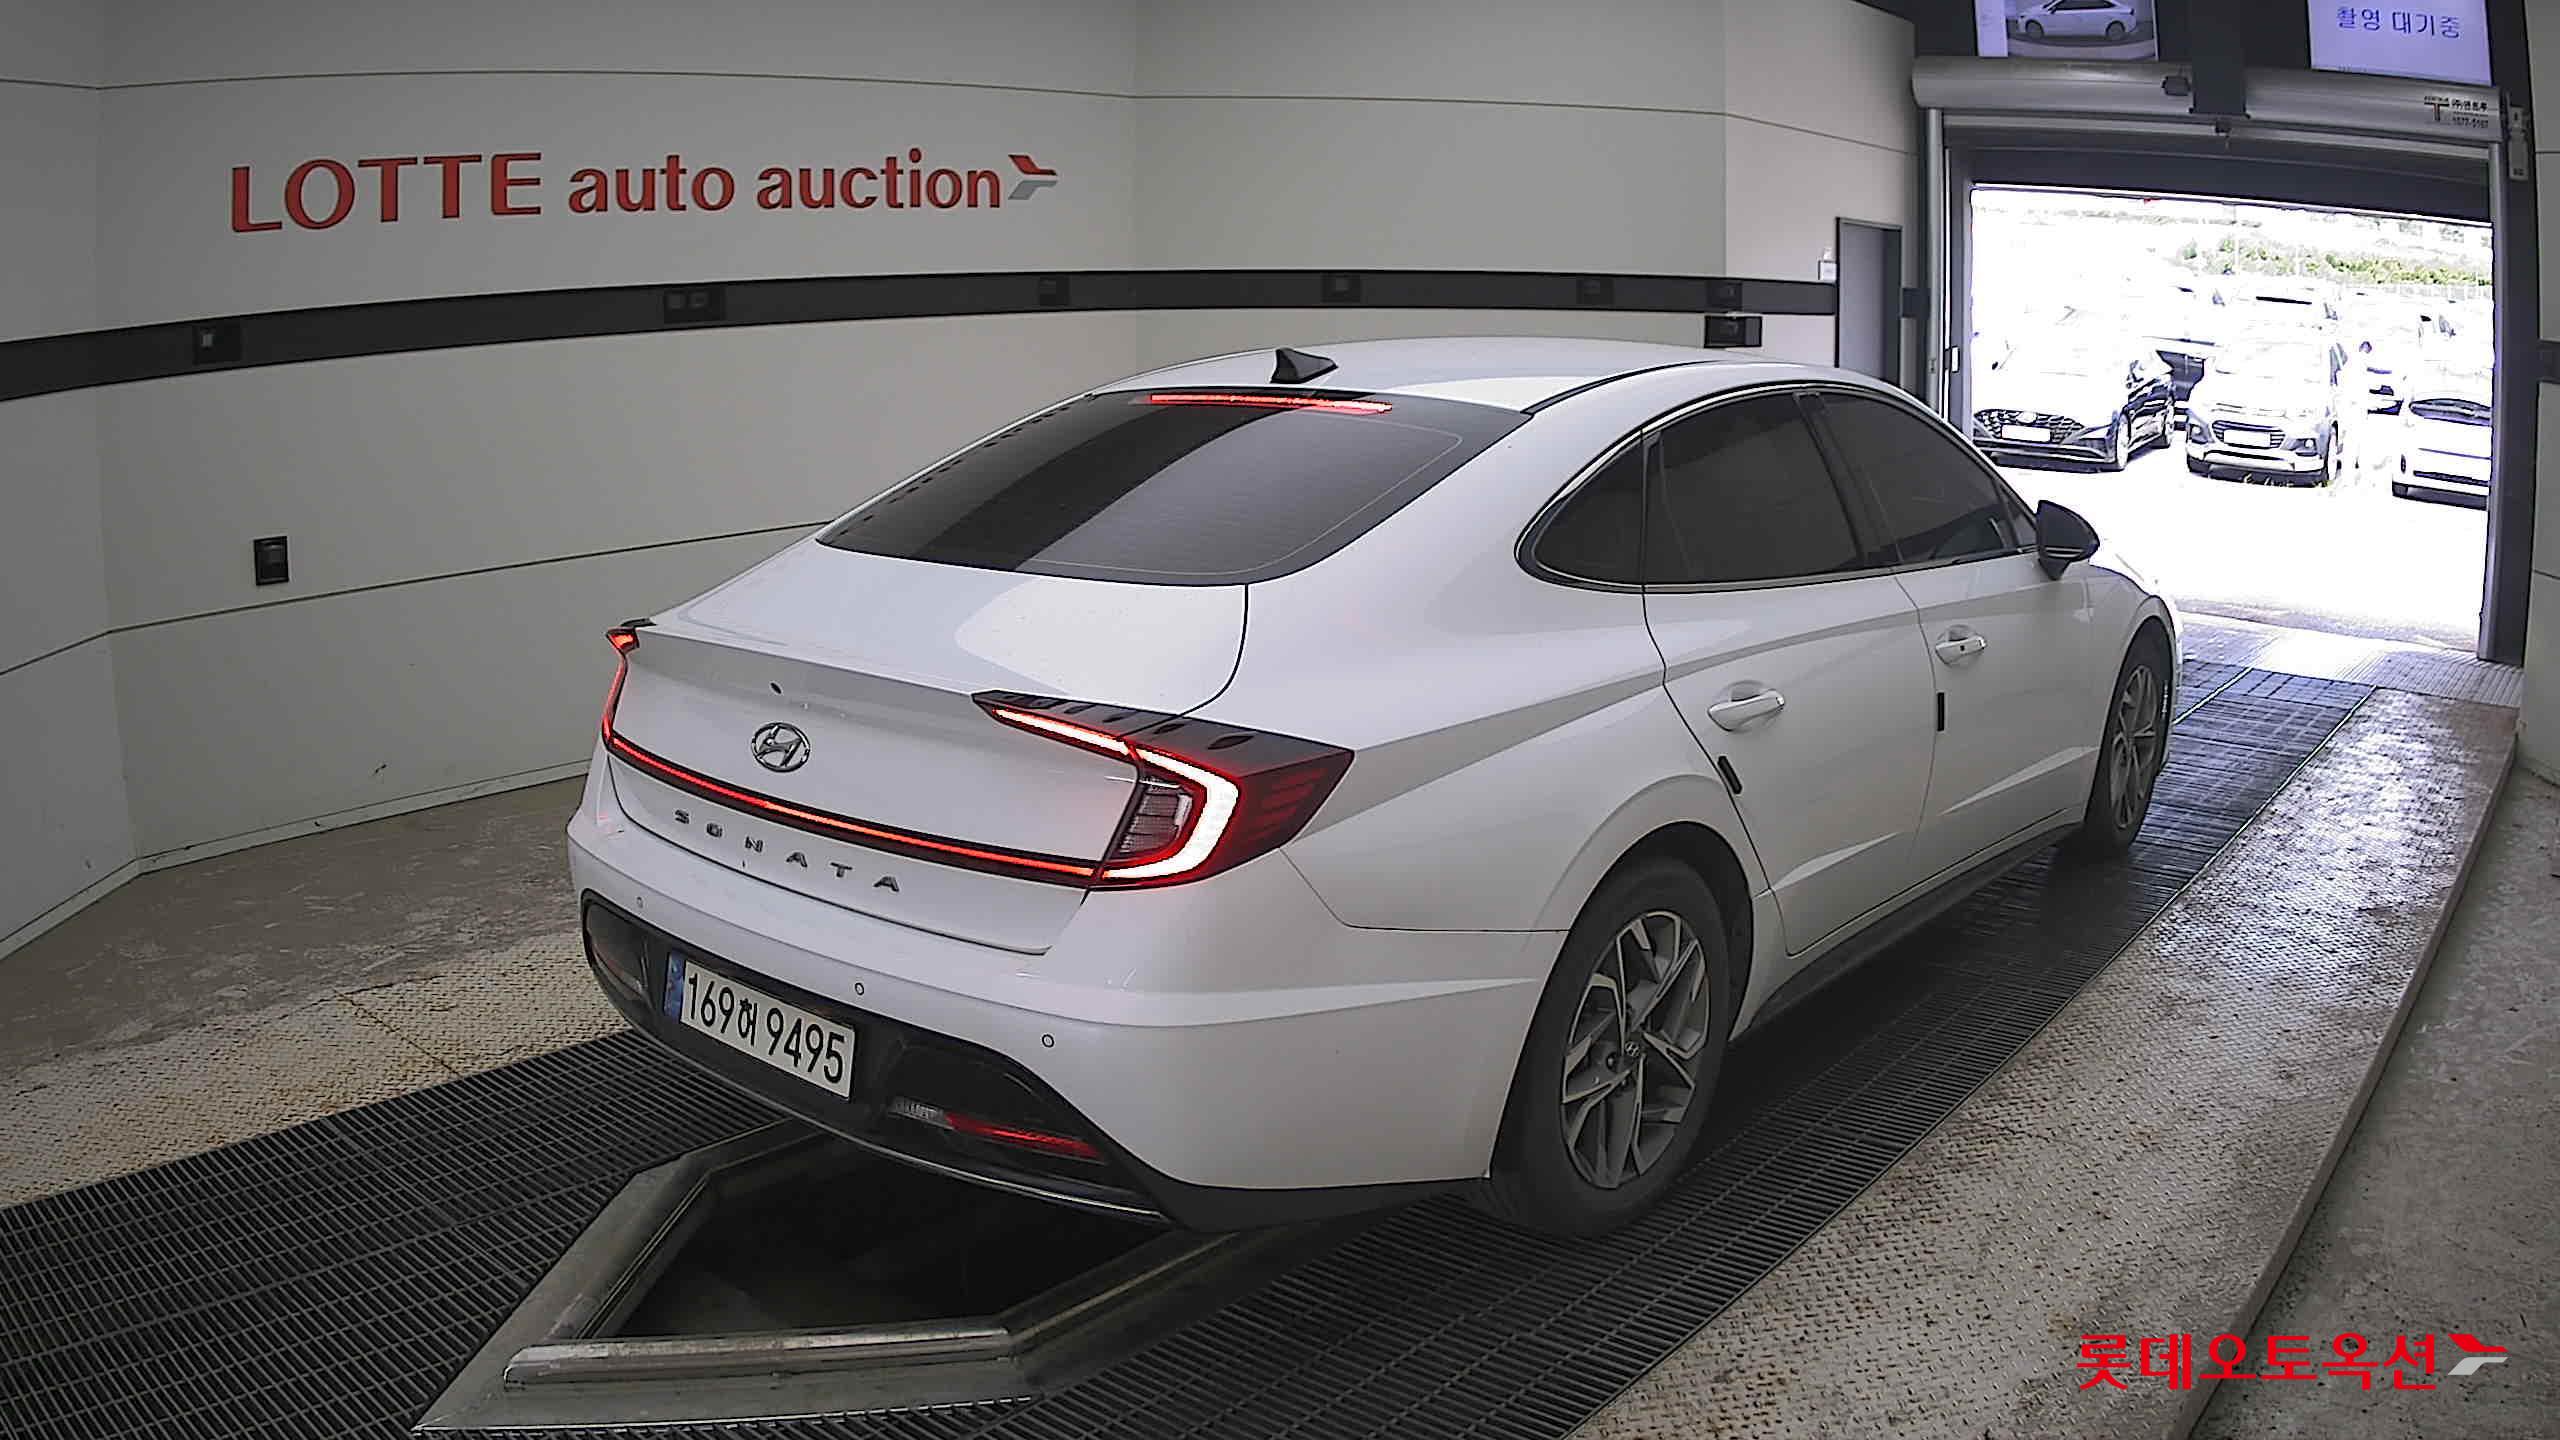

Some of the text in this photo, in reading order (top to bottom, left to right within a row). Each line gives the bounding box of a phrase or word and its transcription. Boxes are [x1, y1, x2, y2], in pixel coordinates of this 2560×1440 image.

[2337, 6, 2460, 39] 촬영 대기중
[231, 149, 1000, 232] LOTTE auto auction
[675, 809, 900, 893] SONATA
[766, 1007, 845, 1084] 9495
